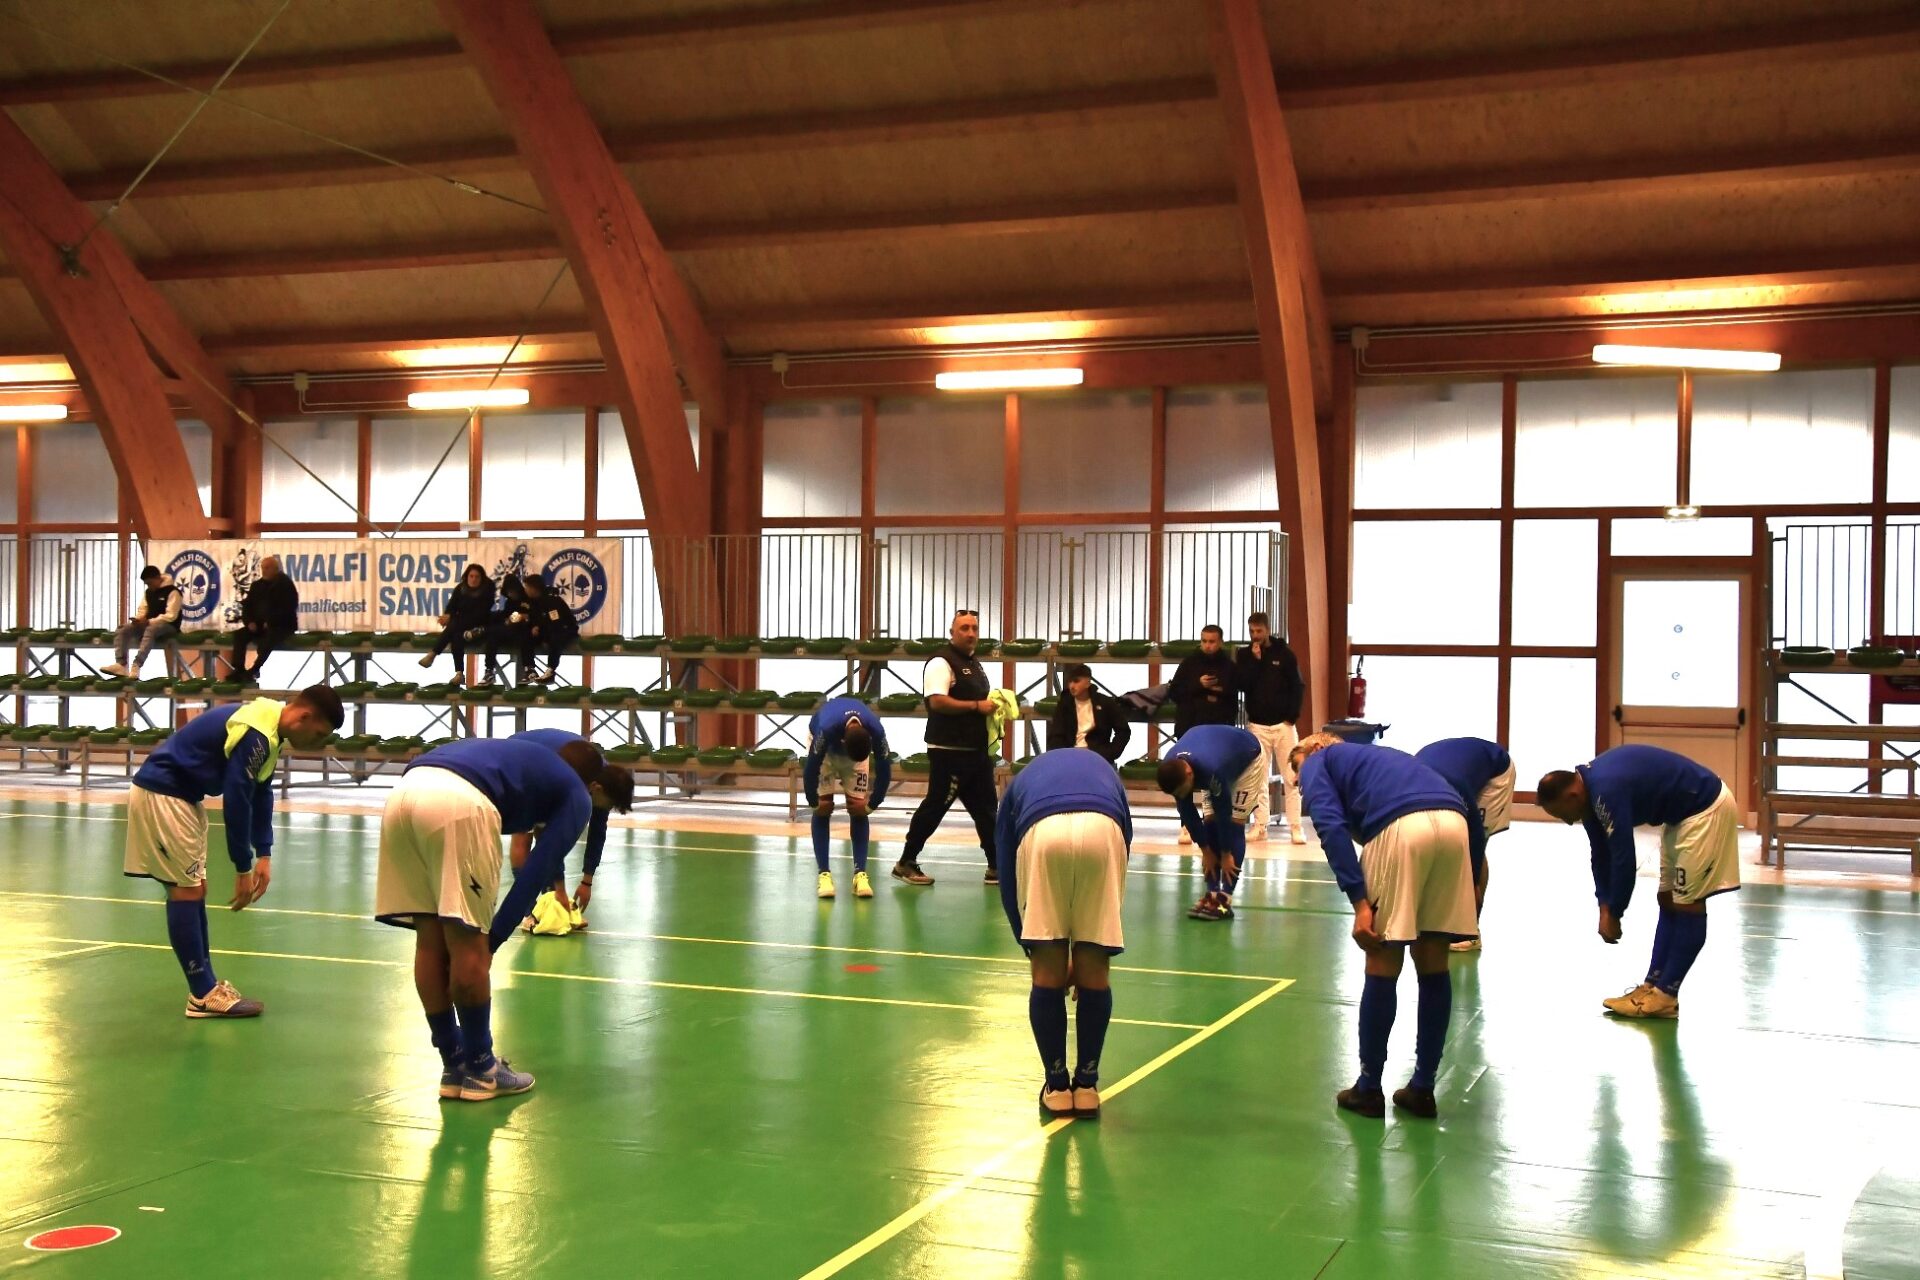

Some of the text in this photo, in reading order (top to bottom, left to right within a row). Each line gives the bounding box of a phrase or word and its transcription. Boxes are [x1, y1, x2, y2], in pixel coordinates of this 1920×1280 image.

[378, 553, 468, 583] COAST
[548, 552, 598, 572] AMALFI COAST
[296, 599, 367, 613] malficoast
[1235, 790, 1249, 805] 17
